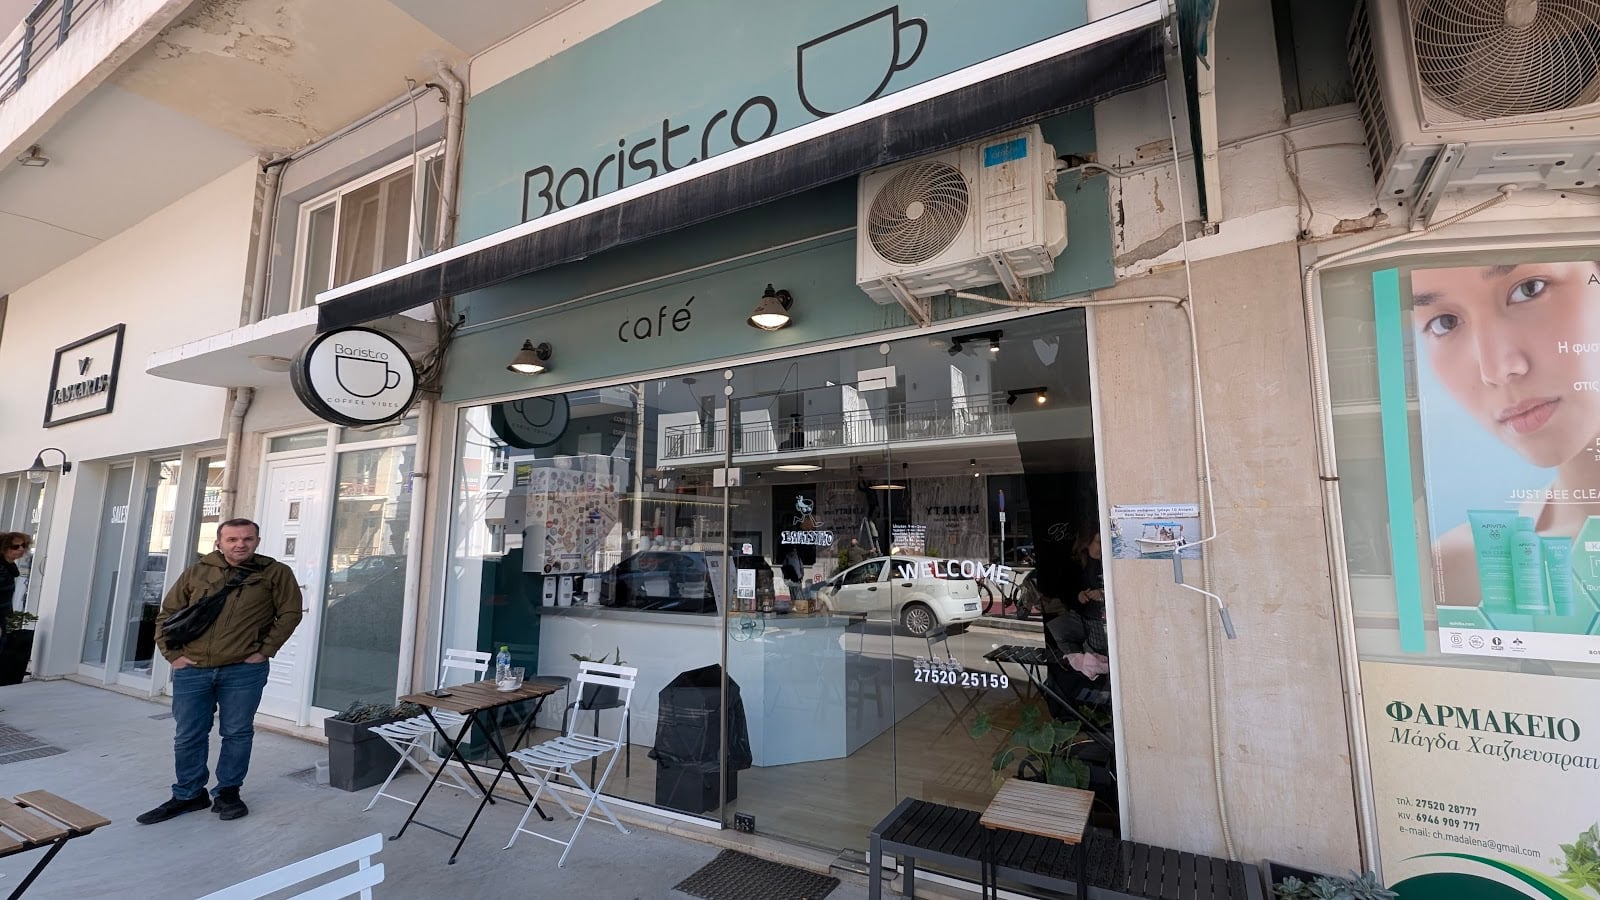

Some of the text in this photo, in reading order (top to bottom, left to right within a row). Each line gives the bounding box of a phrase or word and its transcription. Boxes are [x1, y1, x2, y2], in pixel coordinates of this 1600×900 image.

[521, 95, 778, 223] Baristro
[618, 295, 695, 343] café
[335, 343, 389, 361] Baristro
[327, 397, 366, 406] COFFEE
[1510, 489, 1540, 499] JUST
[1545, 489, 1569, 499] BEE
[898, 559, 1012, 585] WELCOME
[914, 668, 1009, 689] 27520 25159
[1386, 701, 1581, 743] ΦΑΡΜΑΚΕΙΟ
[1388, 726, 1460, 753] Μάγδα
[1416, 798, 1445, 811] 27520
[1448, 804, 1477, 816] 28777
[1416, 813, 1440, 825] 6946
[1442, 817, 1460, 828] 909
[1463, 820, 1480, 832] 777
[1399, 825, 1541, 858] e-mail: ch.madalena@gmail.com
